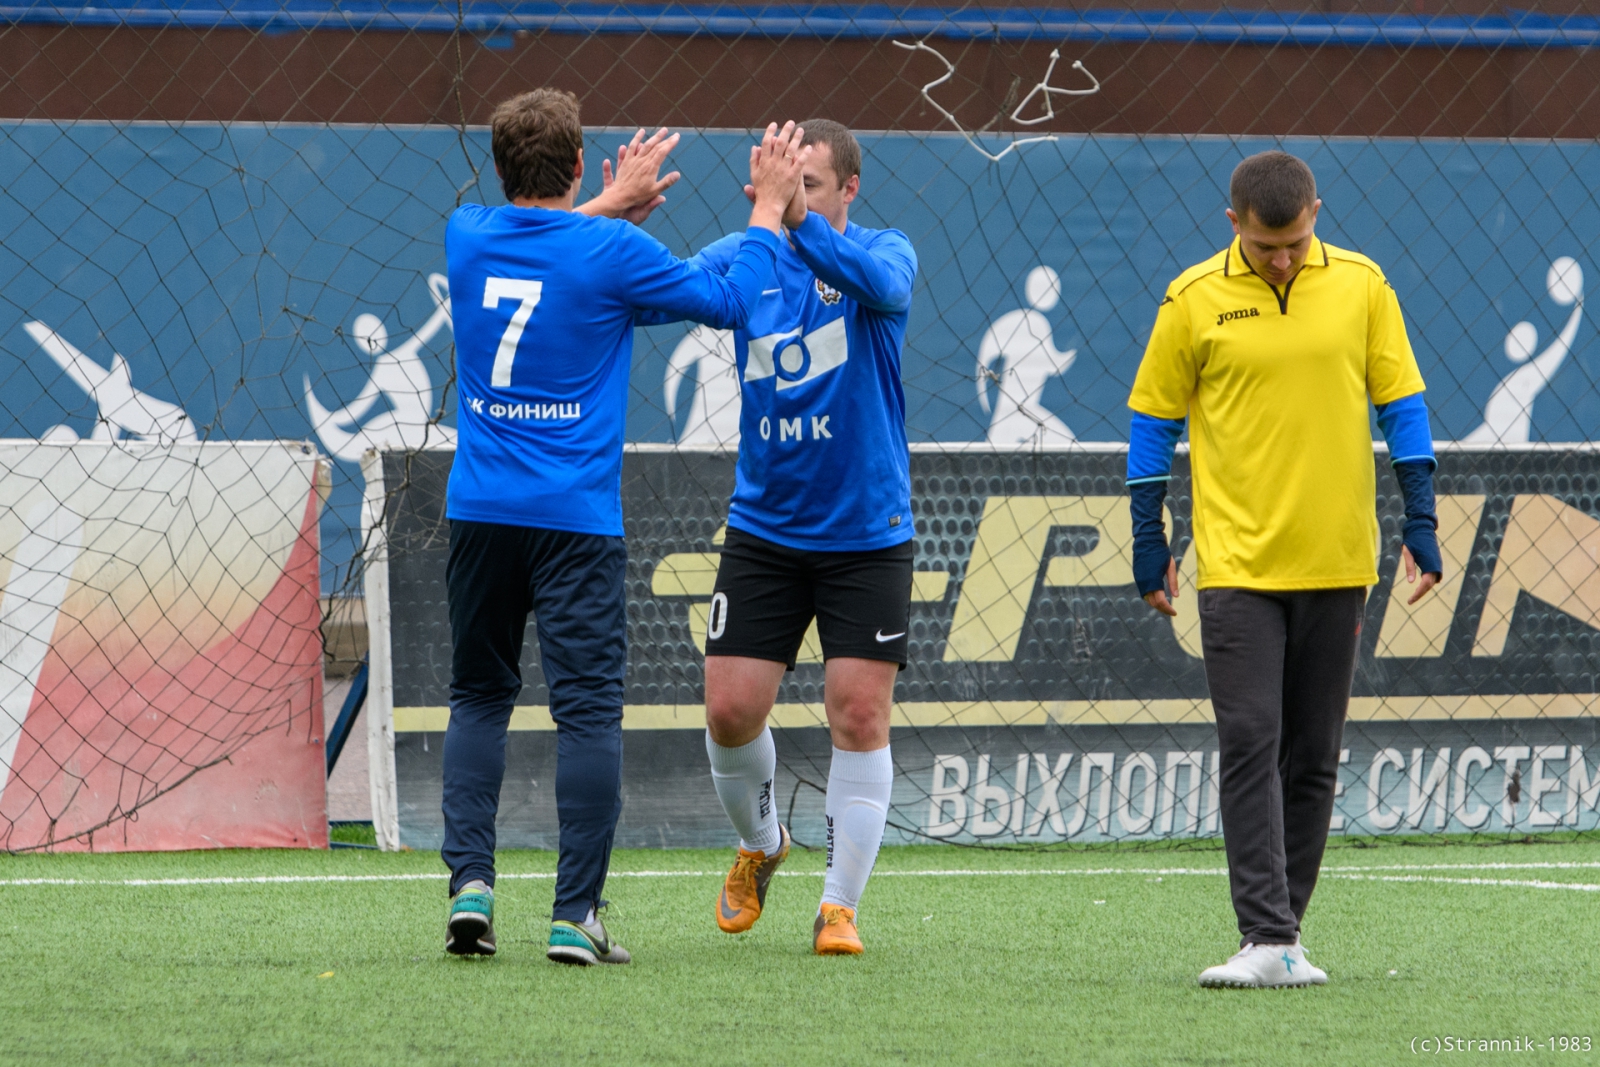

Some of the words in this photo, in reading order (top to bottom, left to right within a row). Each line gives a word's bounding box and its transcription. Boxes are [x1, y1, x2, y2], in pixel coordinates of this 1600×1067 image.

[482, 277, 543, 388] 7
[489, 402, 581, 420] ФИНИШ
[927, 749, 1350, 838] ВЫХЛОП
[1366, 745, 1600, 830] СИСТЕМ
